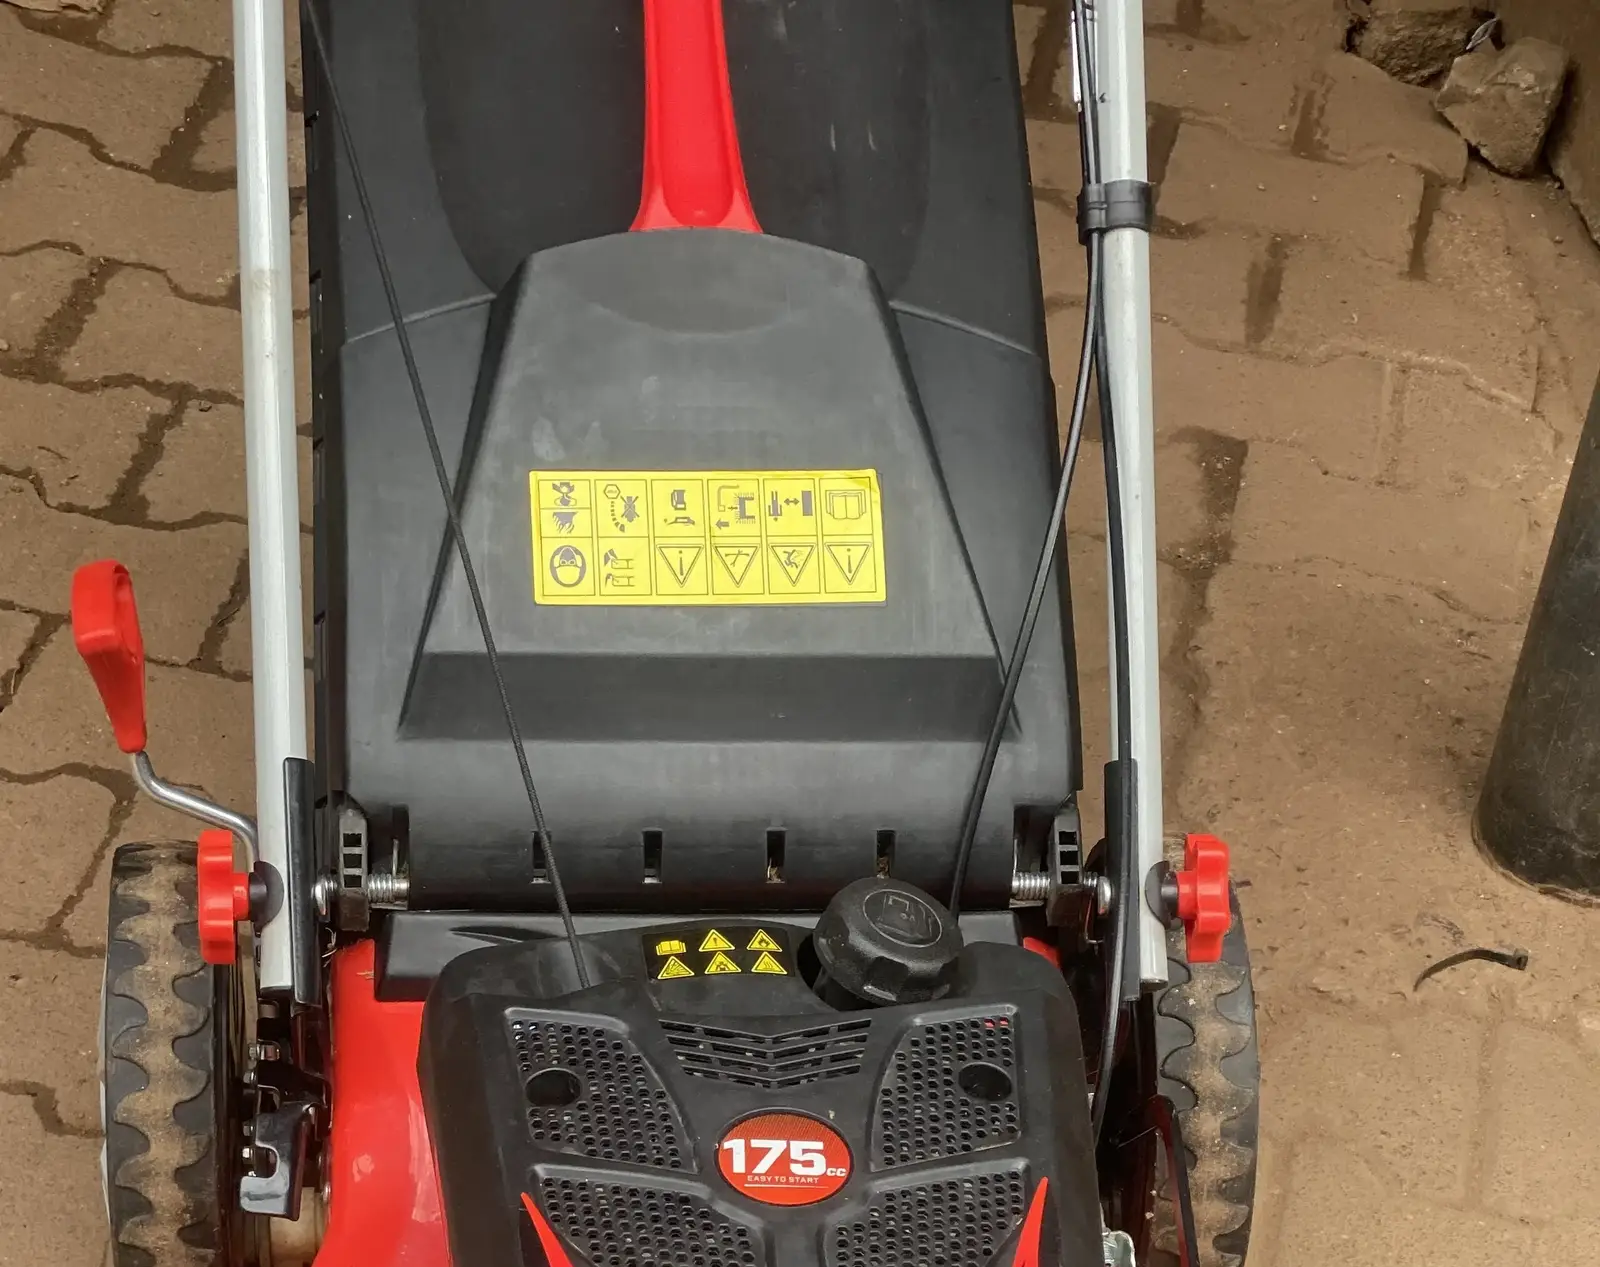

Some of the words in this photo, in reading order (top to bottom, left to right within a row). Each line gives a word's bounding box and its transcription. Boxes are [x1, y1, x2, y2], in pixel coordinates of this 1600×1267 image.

[747, 1175, 772, 1184] EASY
[775, 1175, 787, 1184] TO
[788, 1176, 820, 1185] START
